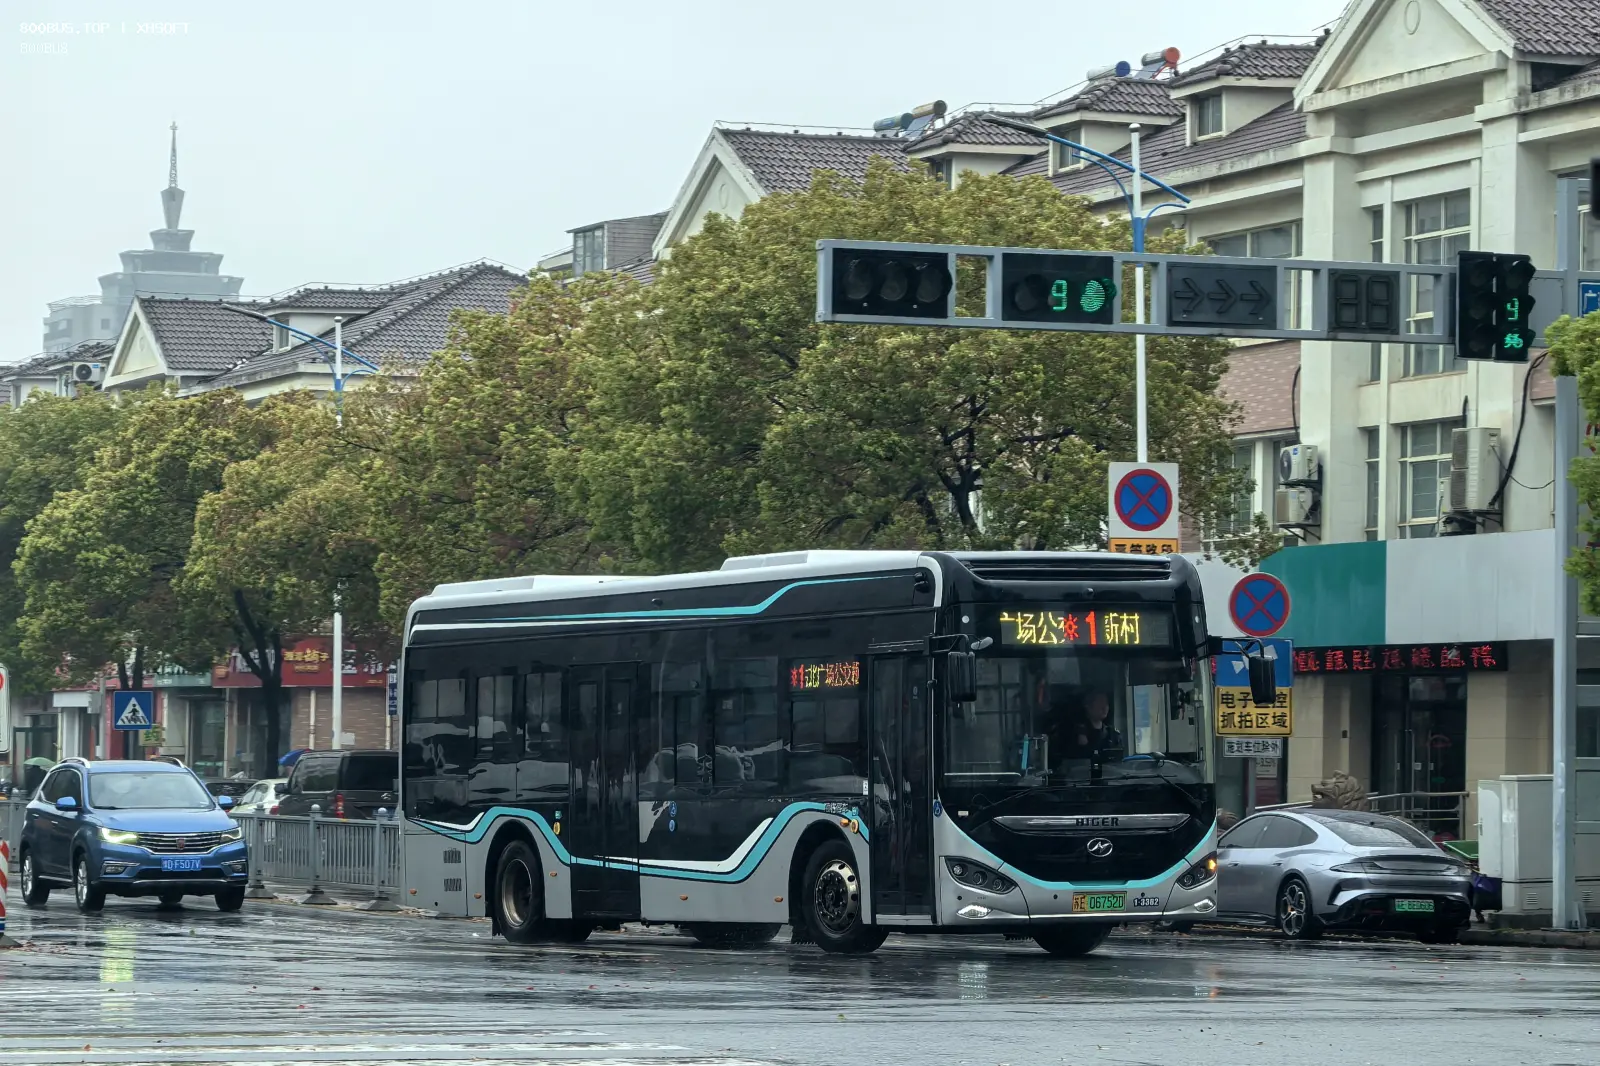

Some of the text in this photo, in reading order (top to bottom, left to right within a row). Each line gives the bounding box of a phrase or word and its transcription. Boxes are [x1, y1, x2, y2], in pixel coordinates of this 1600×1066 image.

[1051, 279, 1068, 311] 9
[1085, 610, 1097, 646] 1
[1220, 691, 1288, 709] 电子控
[1220, 711, 1289, 729] 抓拍区域
[1075, 816, 1120, 828] HIGER
